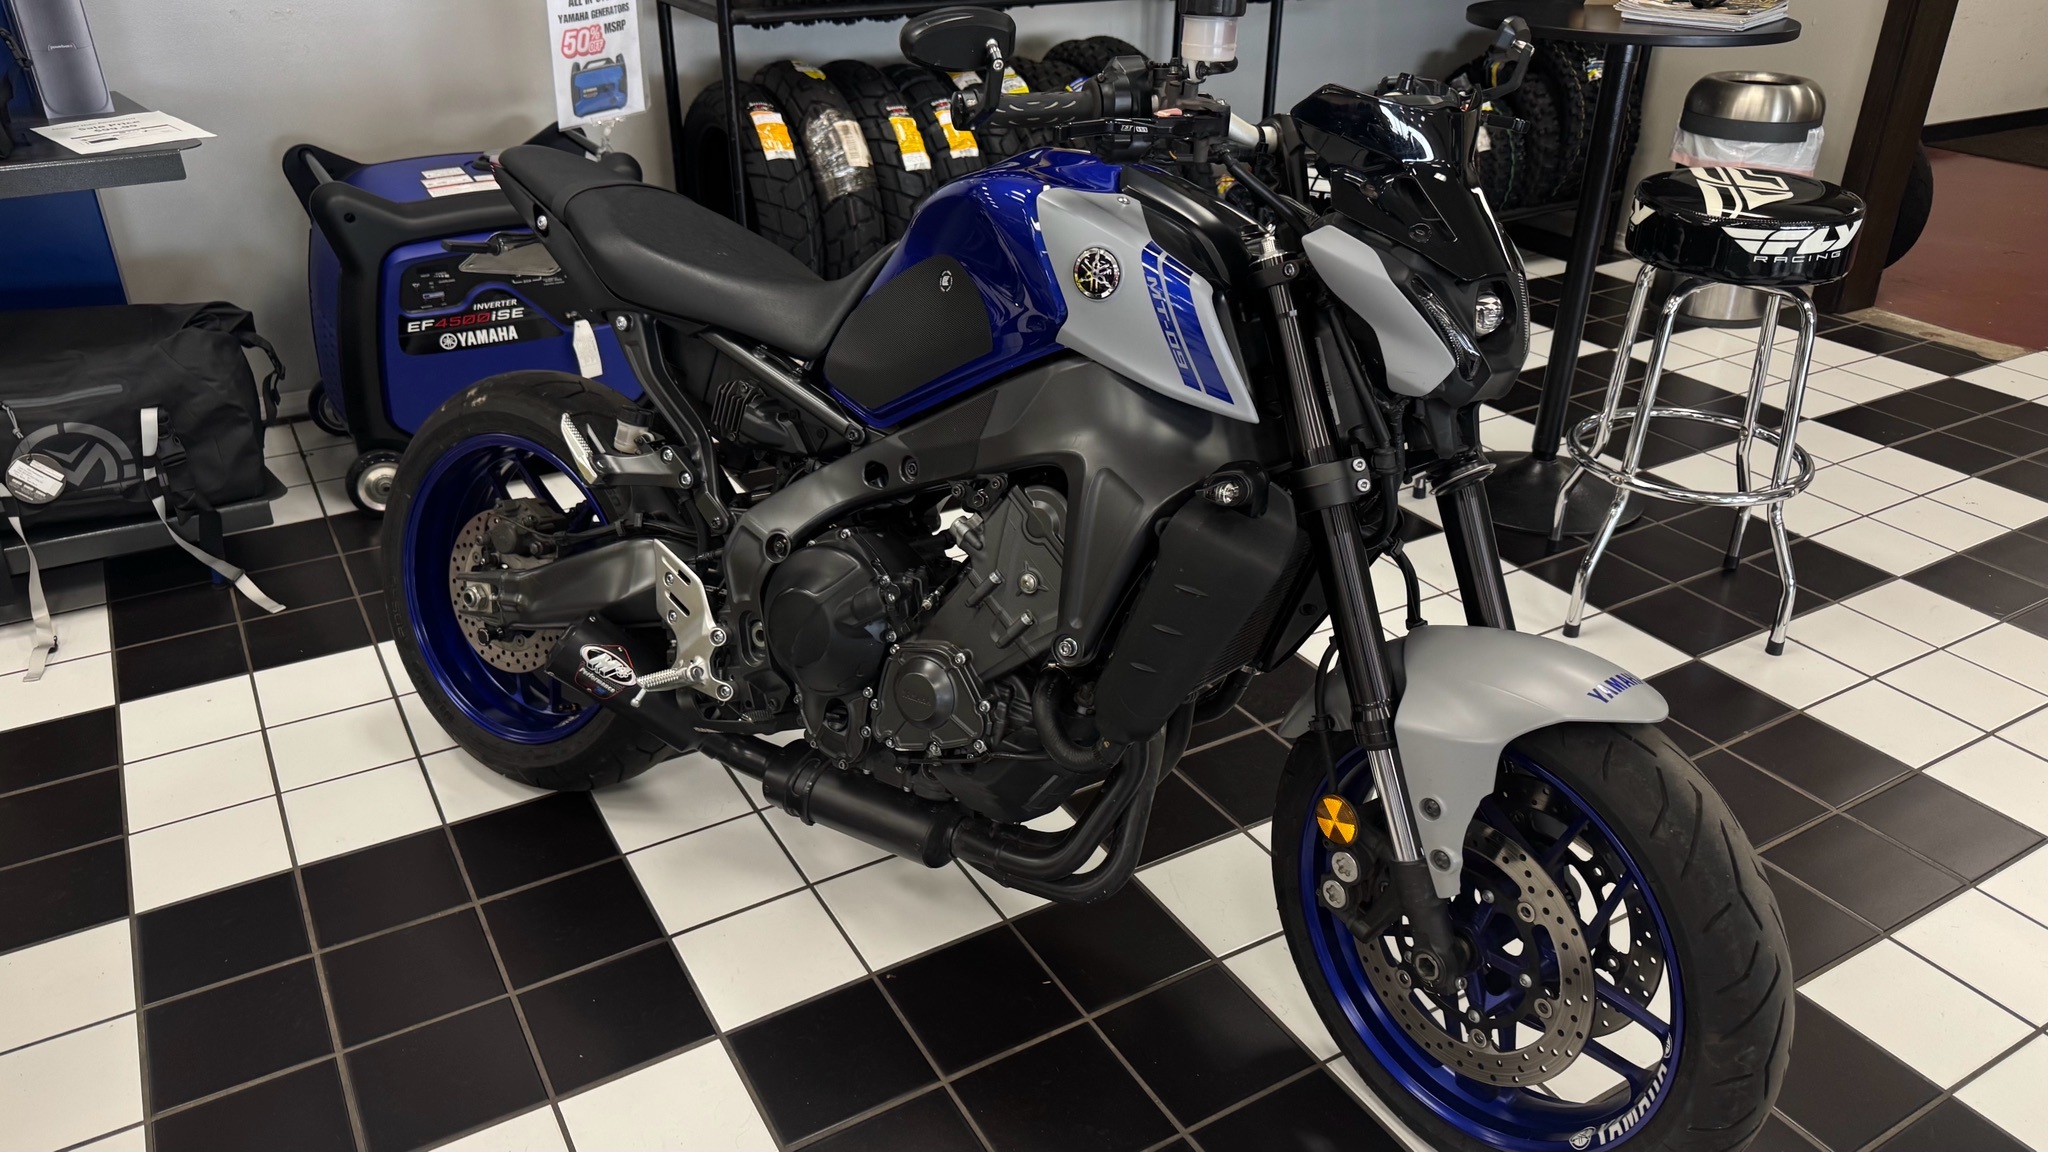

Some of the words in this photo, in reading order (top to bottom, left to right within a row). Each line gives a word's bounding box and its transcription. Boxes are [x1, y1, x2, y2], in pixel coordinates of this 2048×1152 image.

[558, 11, 589, 24] YAMAHA
[591, 3, 630, 19] GENERATORS
[604, 19, 627, 34] MSRP
[589, 39, 604, 53] OFF
[1722, 218, 1864, 256] FLY
[1753, 250, 1842, 264] RACING
[473, 298, 518, 311] INVERTER
[407, 307, 525, 333] EF4500iSE
[1146, 275, 1189, 370] MT-09
[457, 325, 519, 347] YAMAHA
